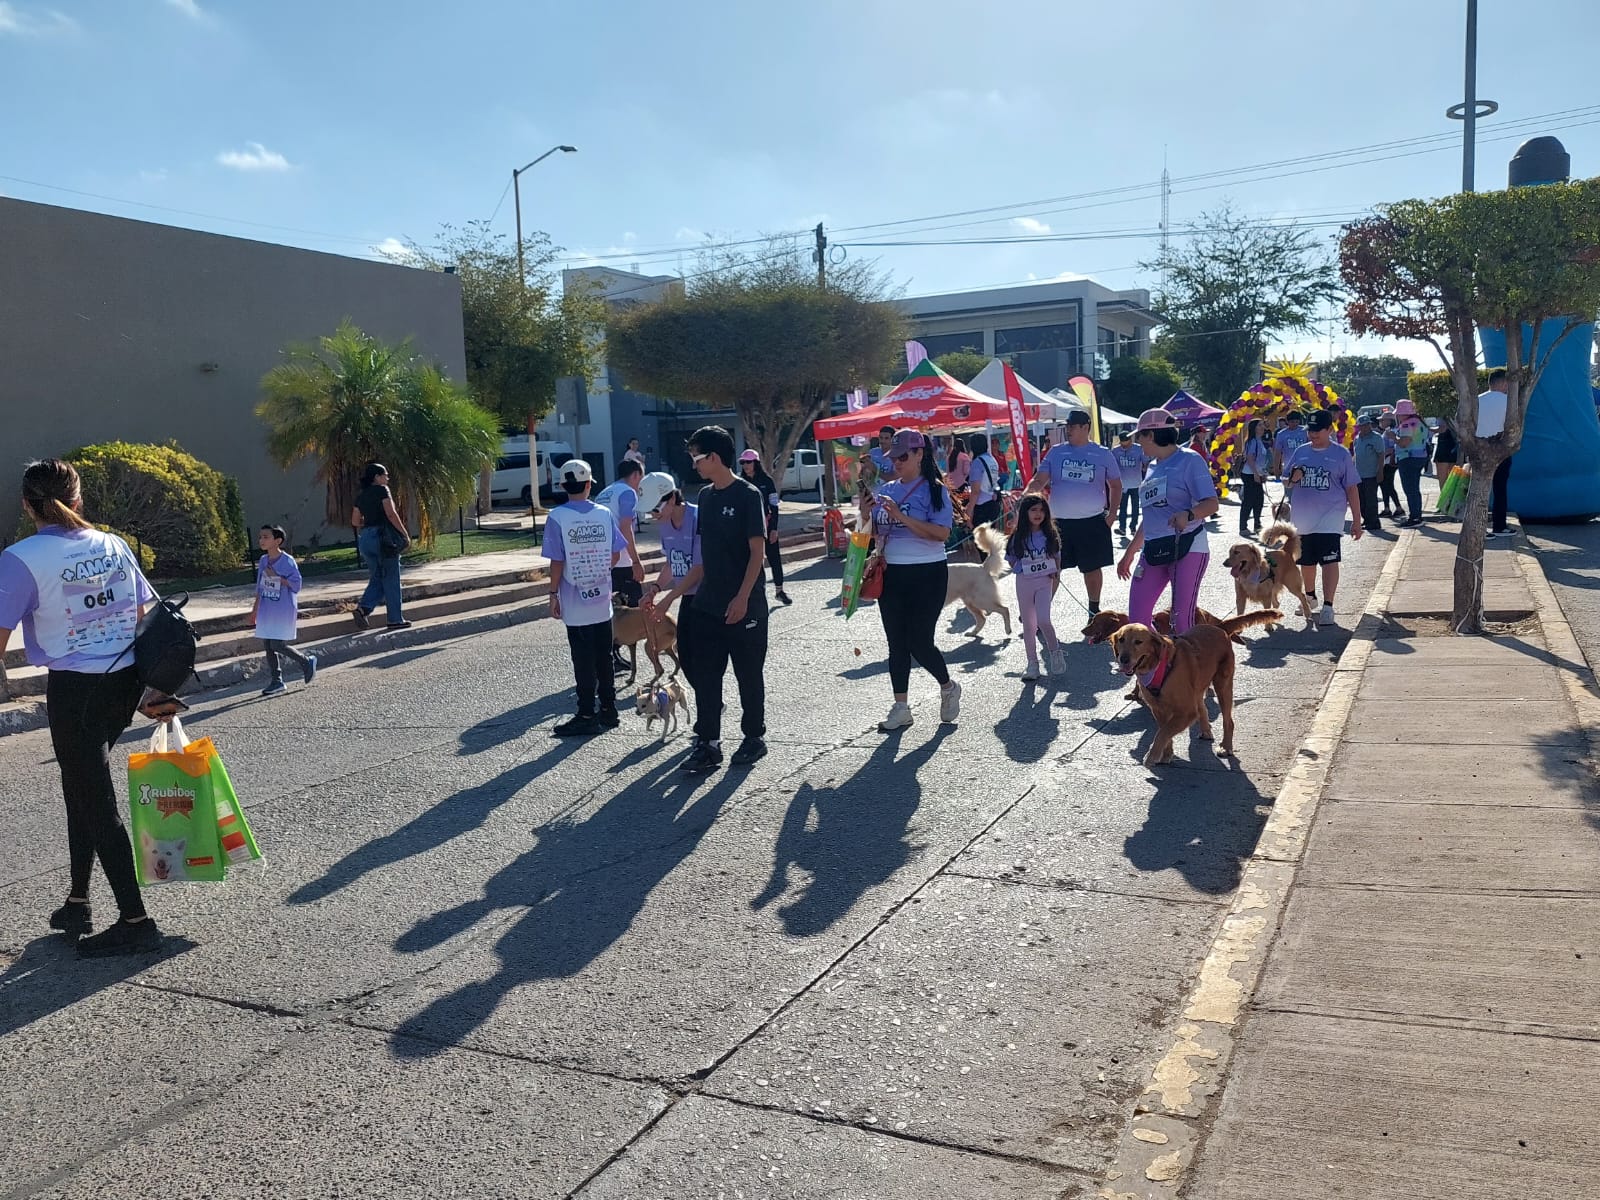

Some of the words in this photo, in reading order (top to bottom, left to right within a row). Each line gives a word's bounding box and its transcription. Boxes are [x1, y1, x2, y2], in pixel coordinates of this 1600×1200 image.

[1031, 562, 1048, 572] 026
[84, 588, 115, 609] 064
[581, 587, 601, 599] 065
[151, 787, 196, 800] RubiDog
